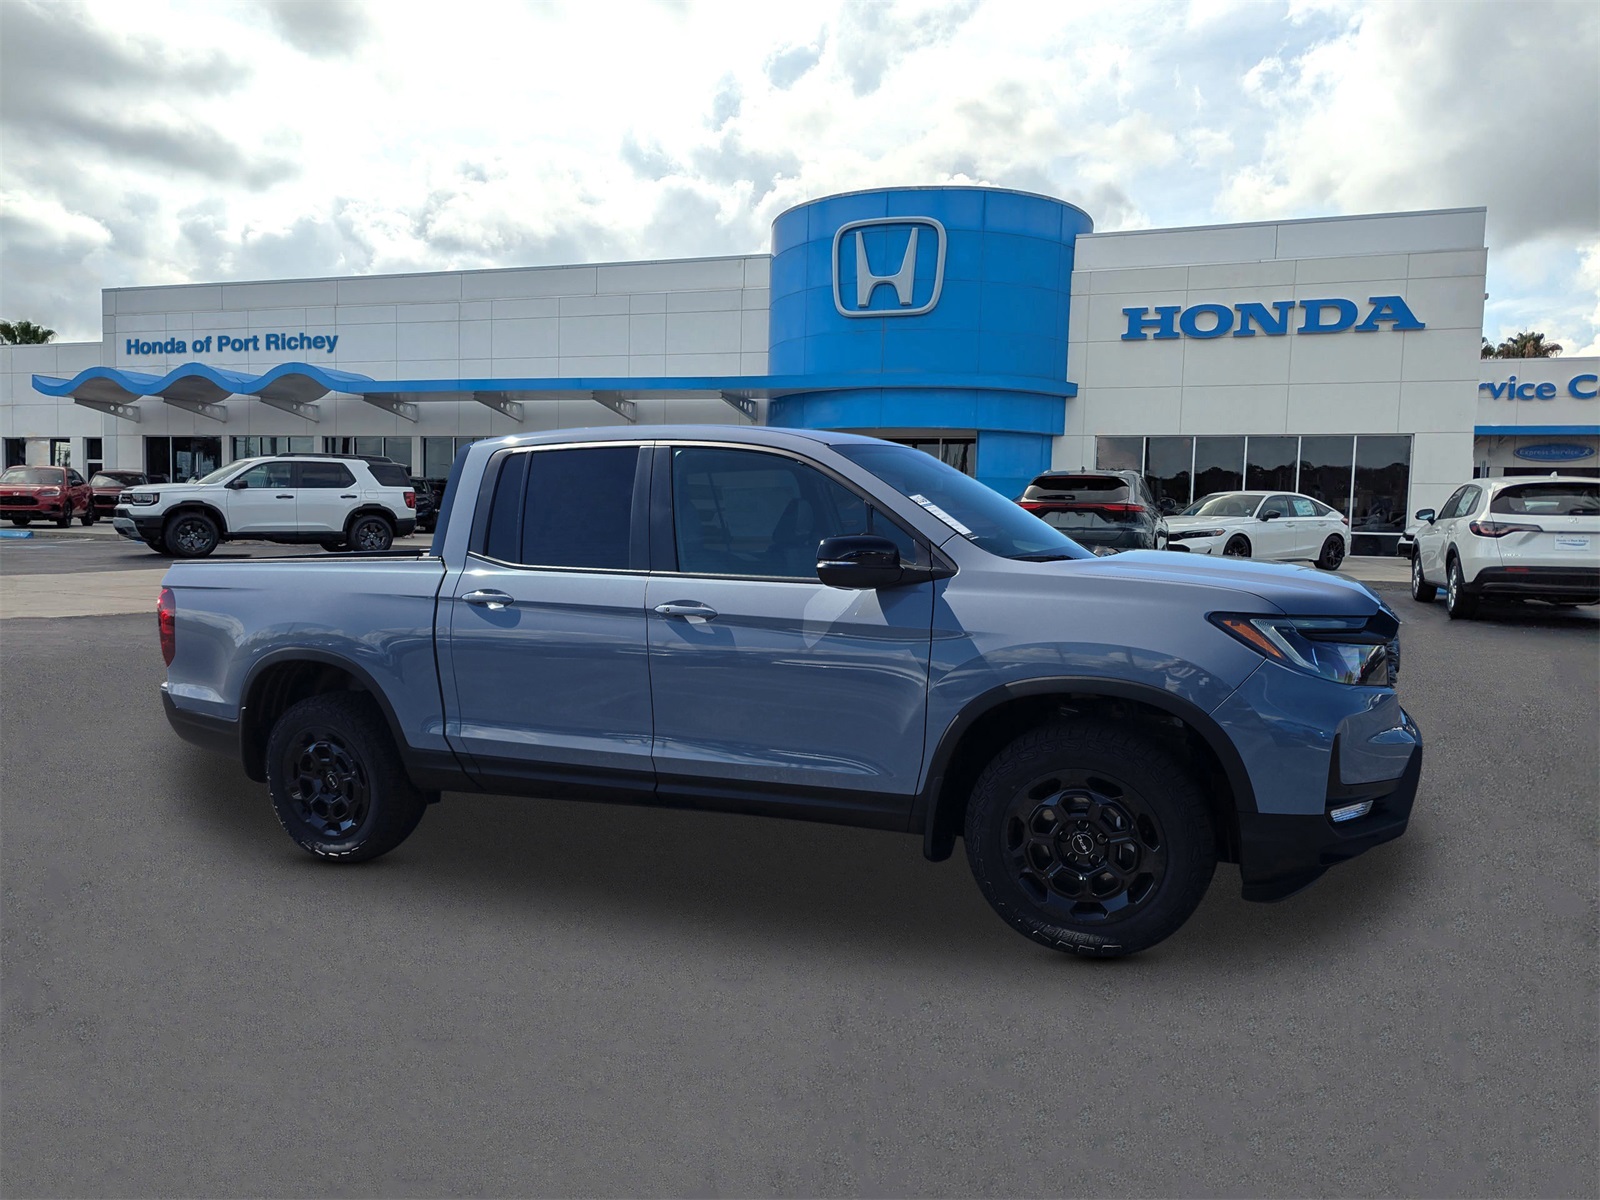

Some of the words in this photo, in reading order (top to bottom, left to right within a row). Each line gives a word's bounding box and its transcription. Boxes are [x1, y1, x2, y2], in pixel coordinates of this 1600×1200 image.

[1121, 295, 1426, 340] HONDA
[126, 337, 187, 356] Honda
[192, 336, 212, 354] of
[217, 335, 259, 353] Port
[265, 333, 338, 354] Richey
[1567, 374, 1600, 400] C
